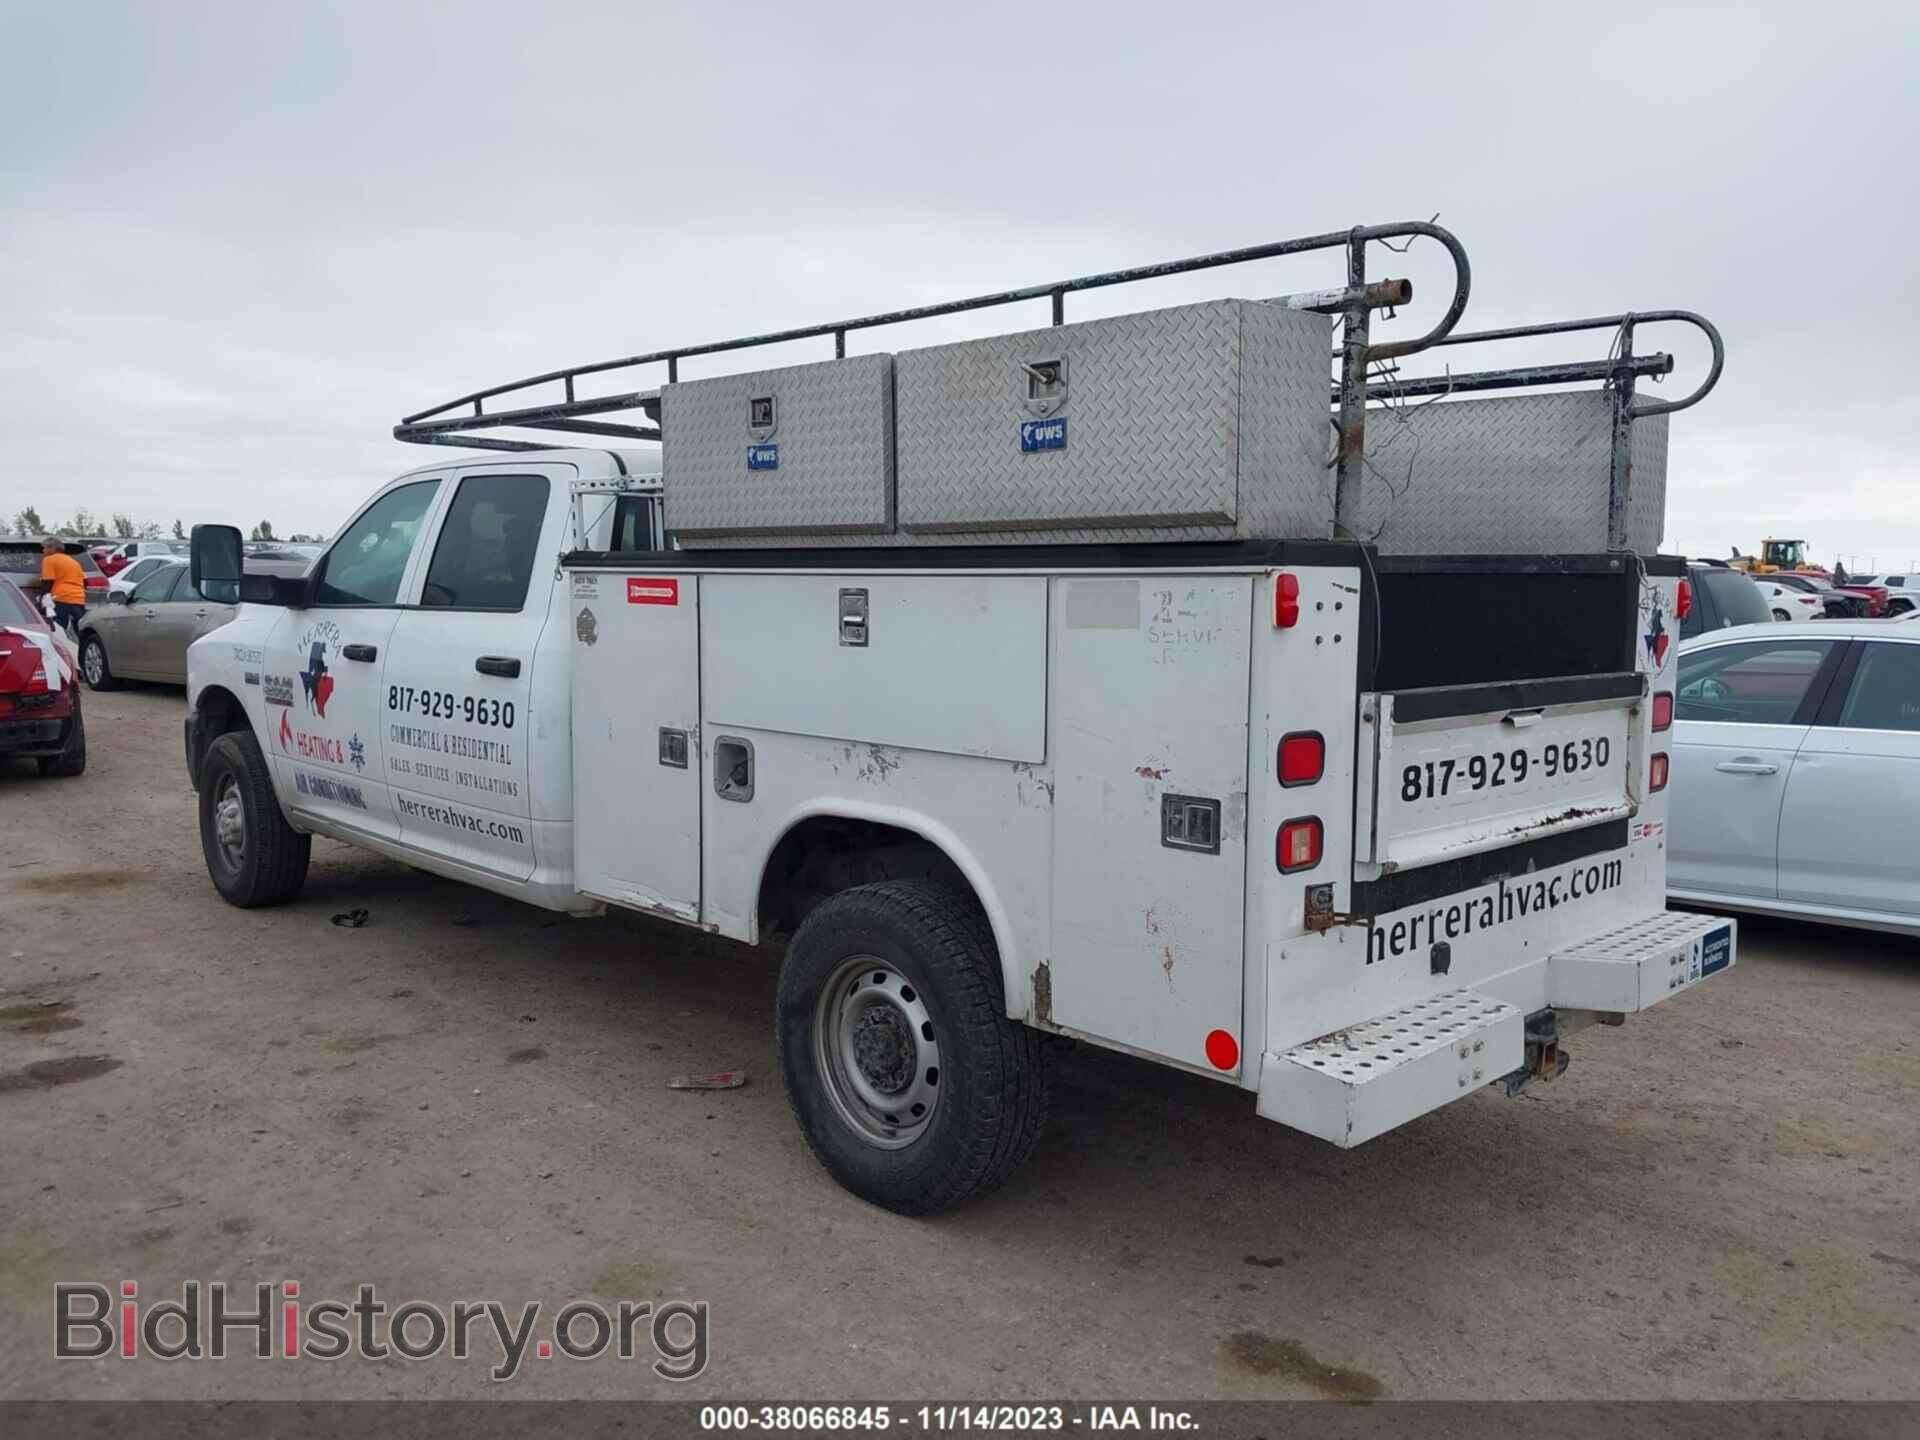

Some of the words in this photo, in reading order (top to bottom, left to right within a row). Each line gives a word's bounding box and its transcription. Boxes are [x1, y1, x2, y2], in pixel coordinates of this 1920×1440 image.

[1035, 425, 1063, 441] UWS
[757, 450, 776, 461] UWS
[388, 685, 515, 729] 817-929-9630
[297, 731, 335, 763] HEATING
[390, 724, 441, 752] COMMERCIAL
[451, 735, 512, 765] RESIDENTIAL
[390, 757, 411, 773] SALES
[415, 762, 449, 782] SERVICES
[455, 770, 518, 797] INSTALLATIONS
[1401, 736, 1610, 802] 817-929-9630
[397, 793, 524, 844] herrerahvac.com
[1366, 858, 1622, 965] herrerahvac.com
